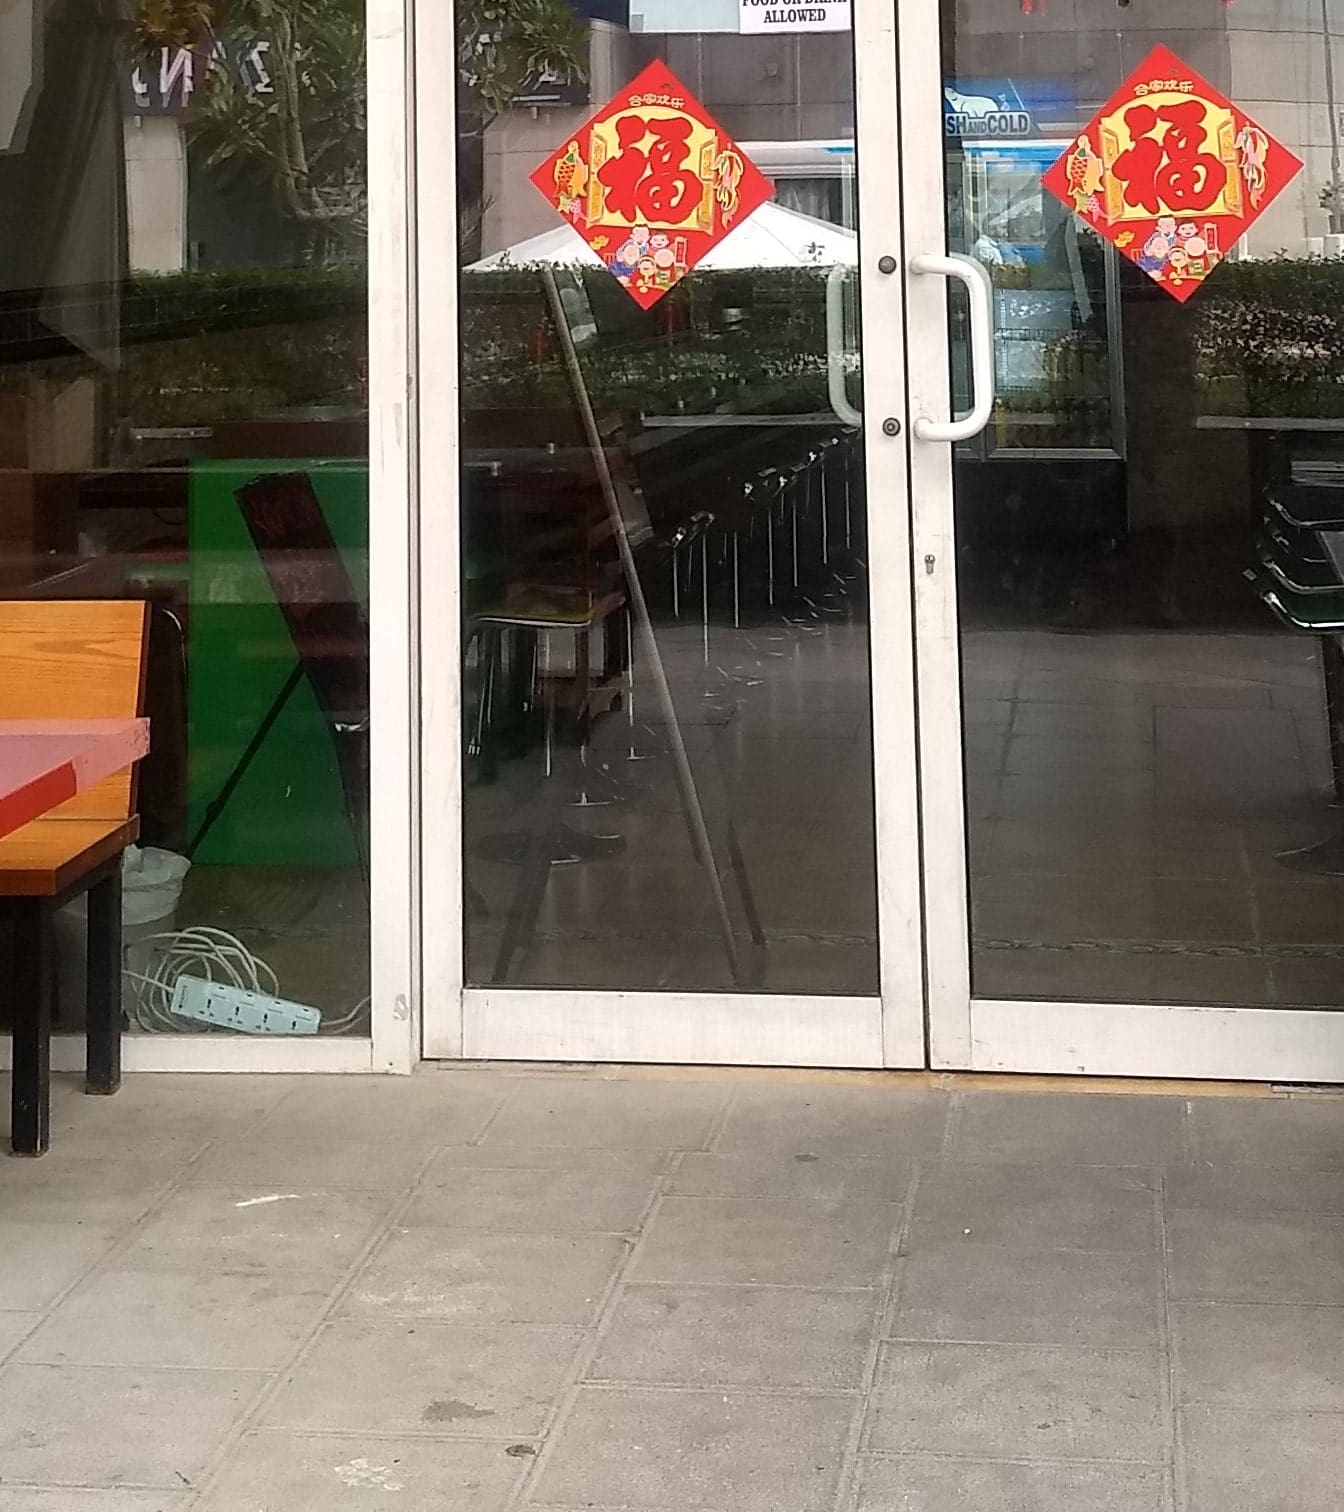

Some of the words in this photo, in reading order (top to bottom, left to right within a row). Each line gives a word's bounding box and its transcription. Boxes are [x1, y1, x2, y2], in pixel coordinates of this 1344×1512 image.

[763, 8, 826, 23] ALLOWED
[596, 114, 704, 224] 福
[1111, 99, 1228, 215] 福
